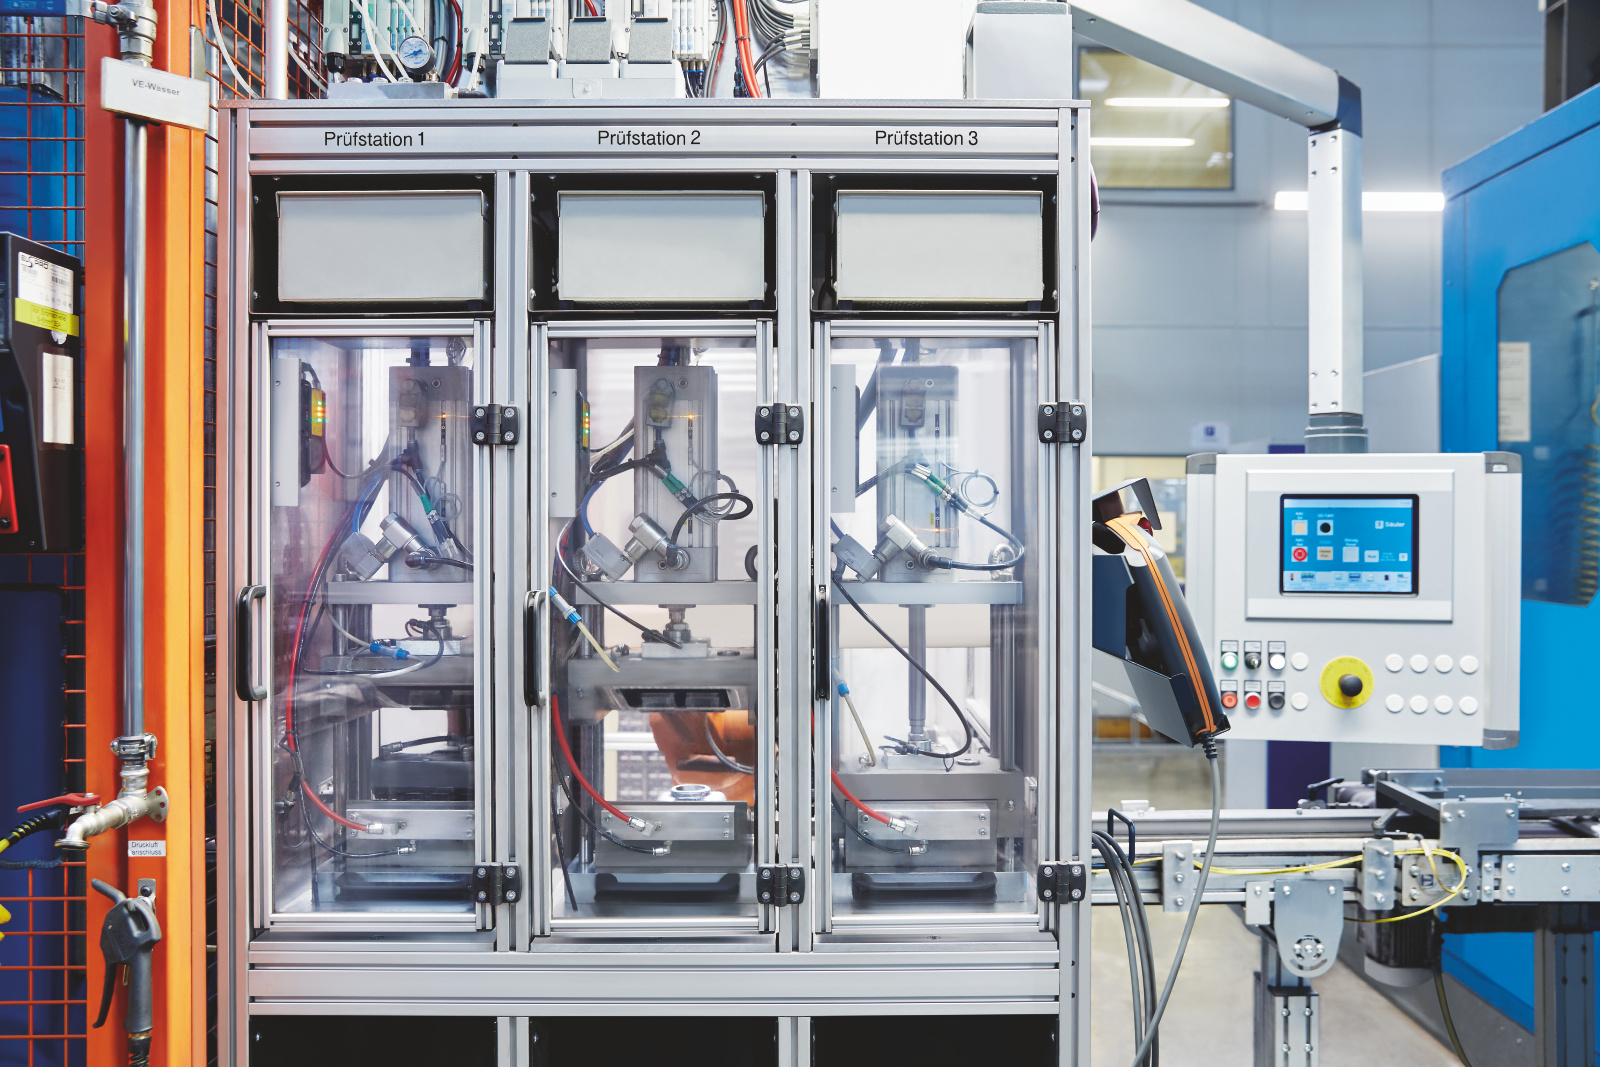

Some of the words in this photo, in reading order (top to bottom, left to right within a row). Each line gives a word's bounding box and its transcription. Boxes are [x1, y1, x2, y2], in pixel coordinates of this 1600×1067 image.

[131, 78, 180, 96] VE-Wasser
[324, 131, 413, 147] Prüfstation
[417, 131, 424, 146] 1
[598, 130, 686, 145] Prüfstation
[690, 129, 701, 145] 2
[875, 130, 963, 146] Prüfstation
[968, 130, 978, 146] 3
